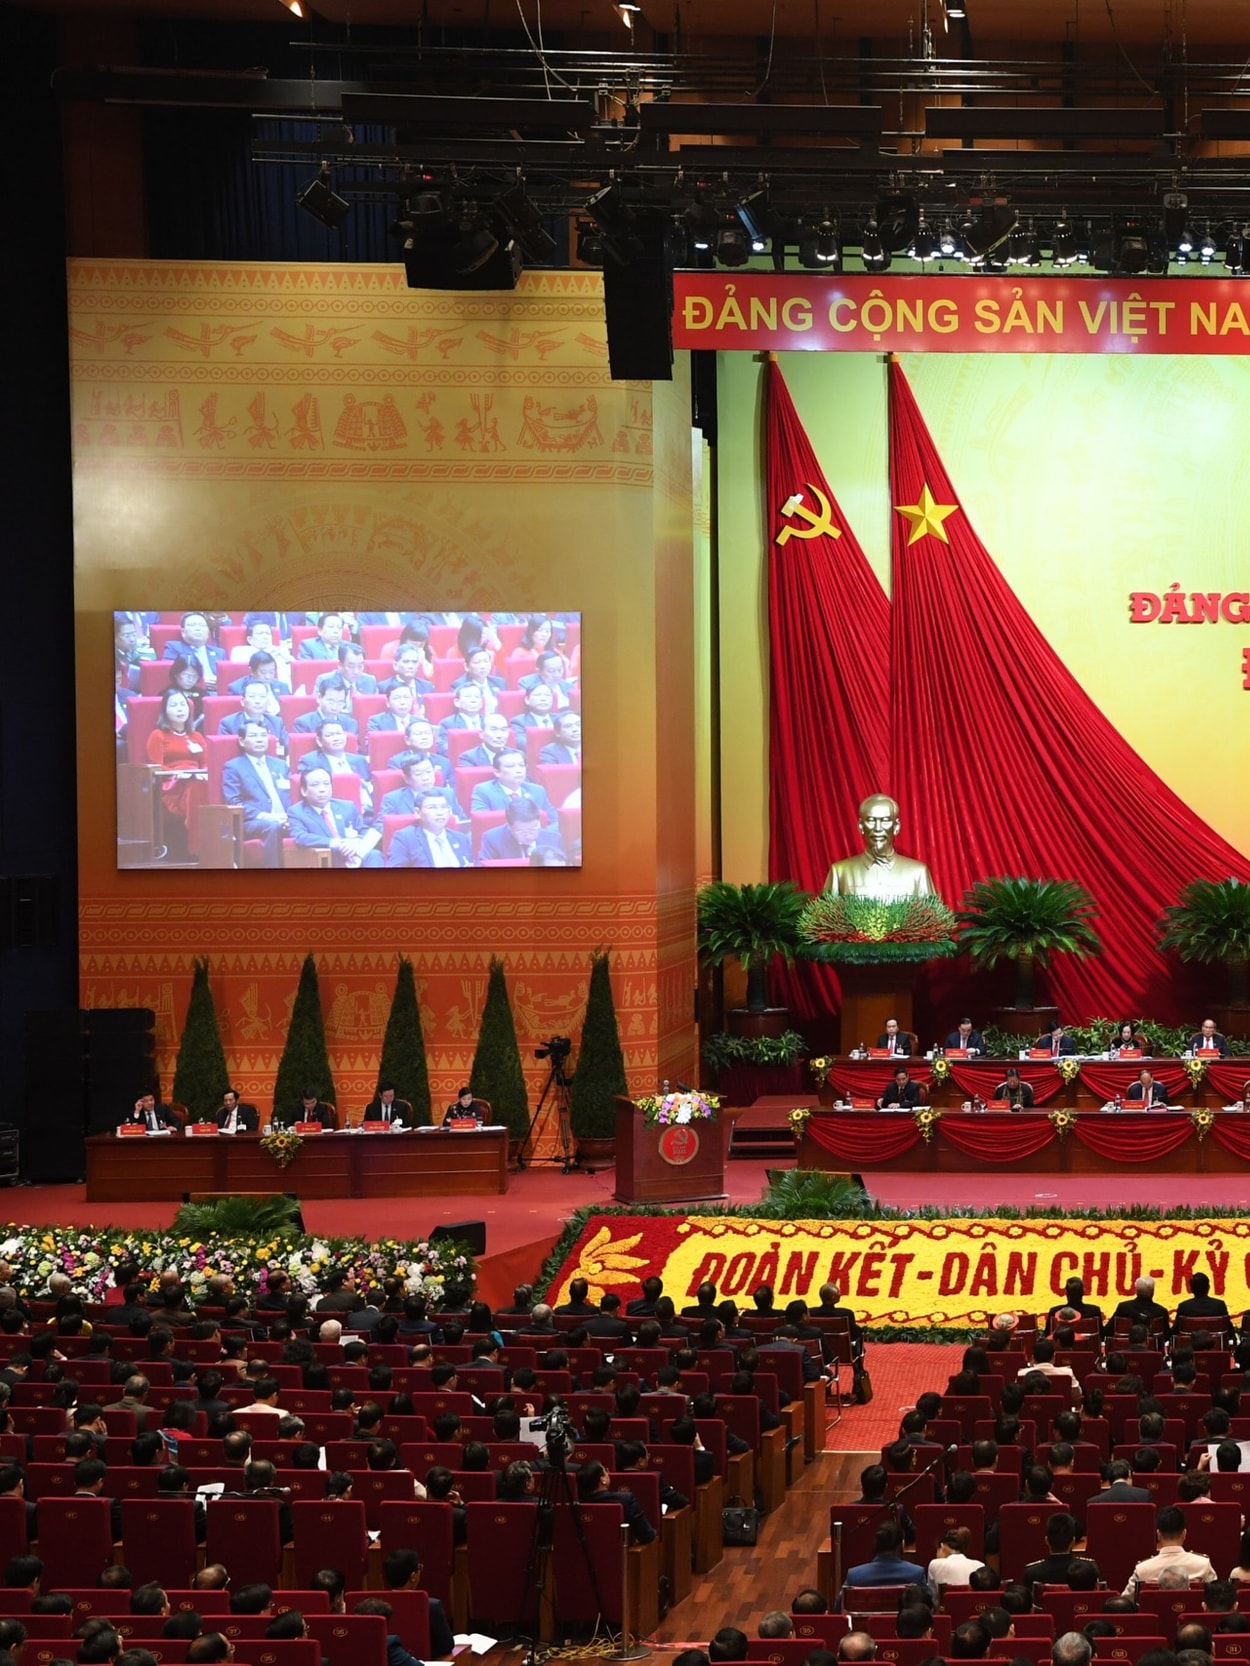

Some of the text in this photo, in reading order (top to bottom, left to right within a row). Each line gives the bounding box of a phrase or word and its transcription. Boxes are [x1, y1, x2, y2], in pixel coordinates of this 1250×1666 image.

[682, 283, 812, 331] ĐẢNG
[827, 290, 959, 342] CỘNG
[974, 286, 1064, 334] SẢN
[1078, 292, 1175, 344] VIỆT
[686, 1242, 820, 1297] ĐOÀN
